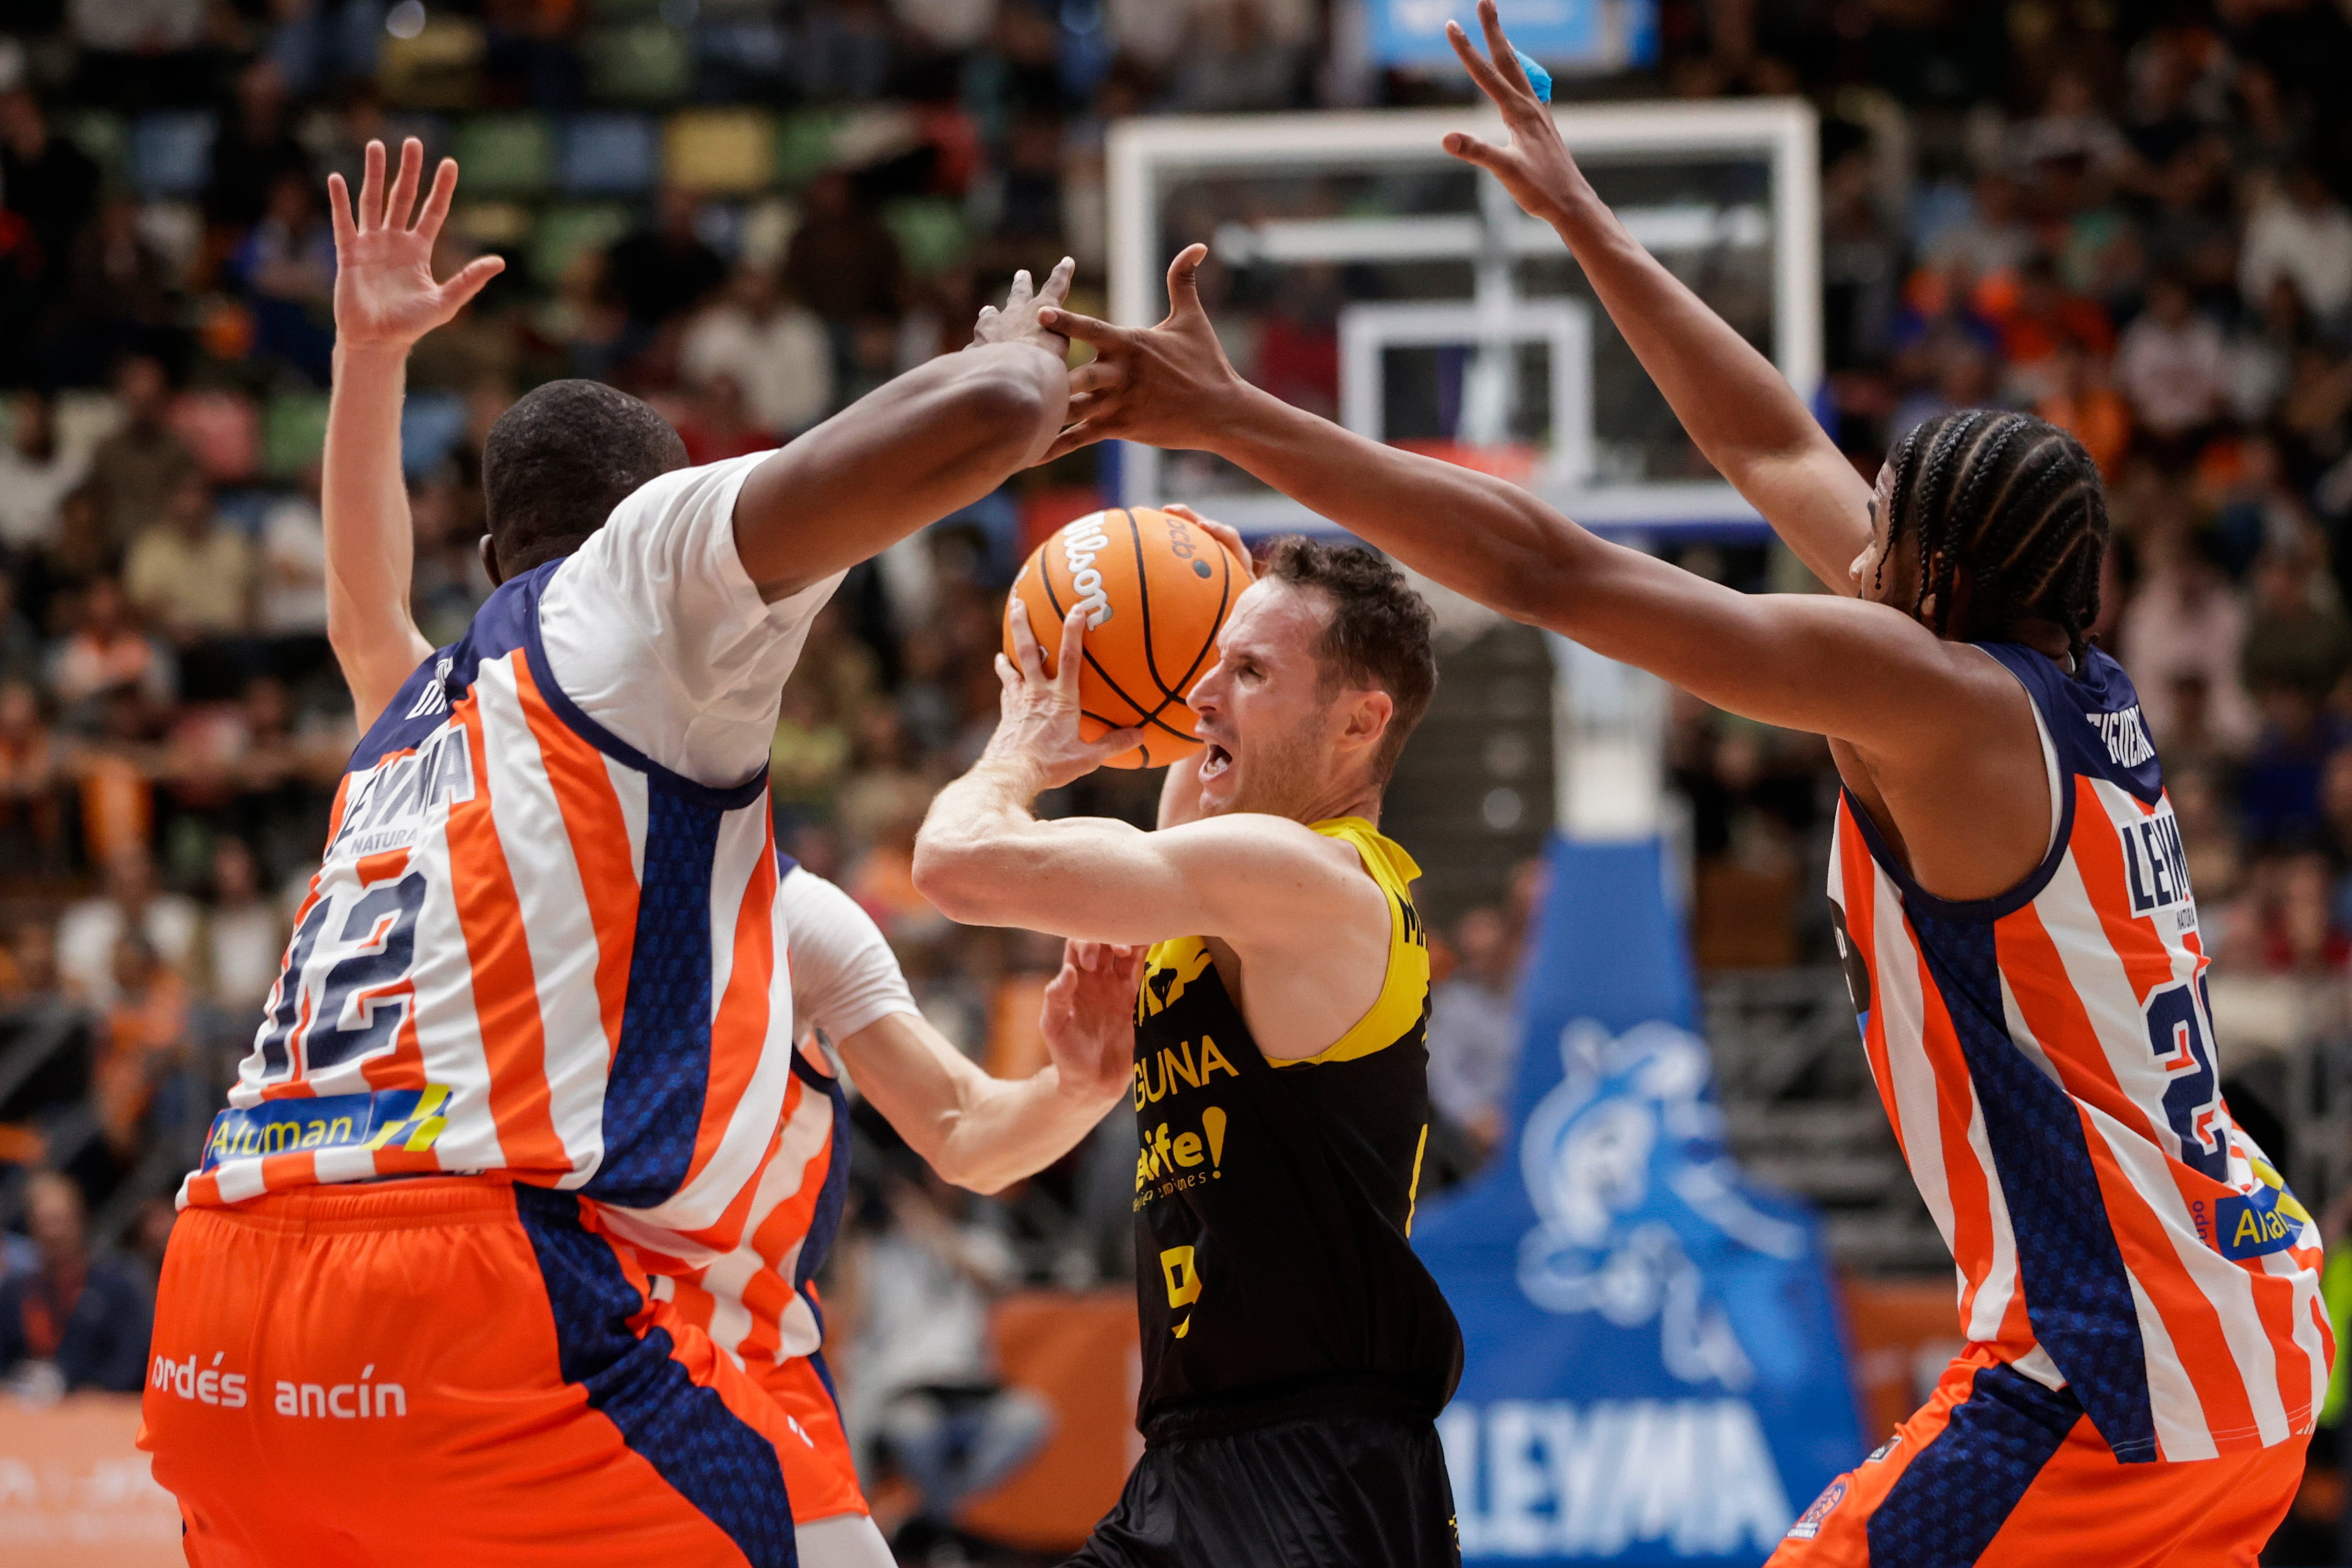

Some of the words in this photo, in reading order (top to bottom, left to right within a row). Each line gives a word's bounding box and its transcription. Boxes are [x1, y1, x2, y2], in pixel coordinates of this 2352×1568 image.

[1165, 518, 1197, 559] acb
[2122, 814, 2192, 912] LEYM
[260, 869, 427, 1079] 12
[2146, 974, 2230, 1184] 2
[207, 1115, 353, 1160] Aluman
[274, 1363, 407, 1419] ancín
[1434, 1397, 1796, 1559] LEYMA
